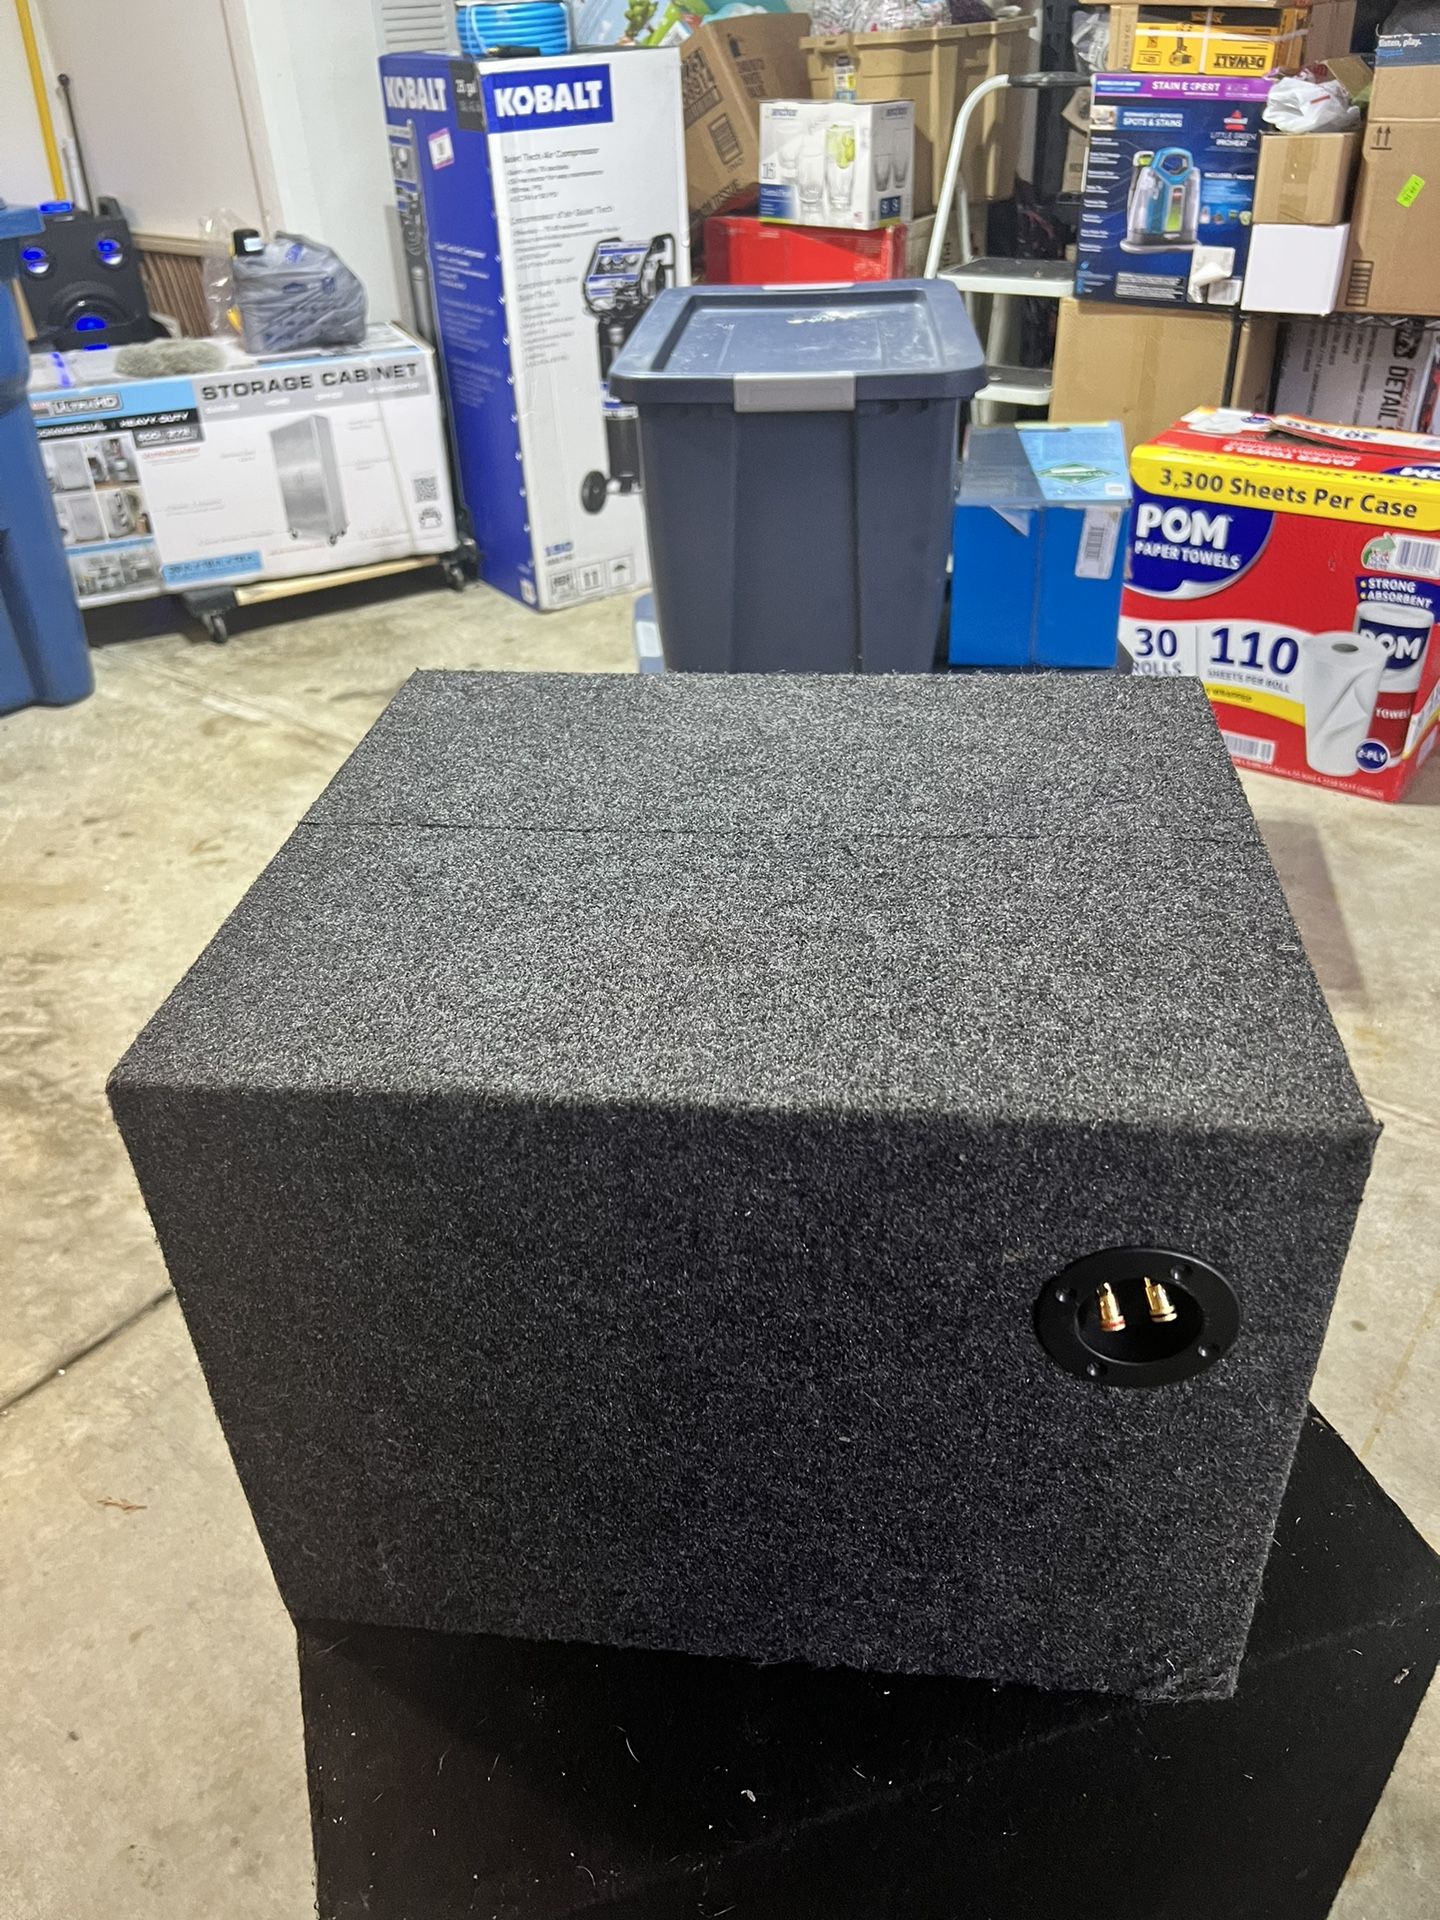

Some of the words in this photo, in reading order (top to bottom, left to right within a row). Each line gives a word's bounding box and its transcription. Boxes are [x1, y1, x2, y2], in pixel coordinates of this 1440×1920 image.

[1213, 55, 1265, 68] DEWALT
[383, 76, 448, 112] KOBALT
[493, 80, 603, 117] KOBALT
[1152, 80, 1180, 91] STAIN
[202, 374, 313, 401] STORAGE
[321, 362, 419, 387] CABINET
[1376, 365, 1409, 422] DETAIL
[1399, 466, 1440, 480] OM
[1160, 467, 1224, 493] 3,300
[1230, 477, 1307, 505] Sheets
[1313, 488, 1354, 510] Per
[1360, 494, 1418, 519] Case
[1135, 502, 1231, 550] POM
[1134, 540, 1180, 562] PAPER
[1181, 546, 1242, 570] TOWELS
[1367, 590, 1433, 609] ABSORBENT
[1368, 577, 1416, 593] STRONG
[1135, 628, 1178, 658] 30
[1210, 626, 1300, 676] 110
[1133, 660, 1182, 675] ROLLS
[1207, 669, 1244, 683] SHEETS
[1245, 675, 1264, 687] PER
[1265, 679, 1291, 695] ROLL
